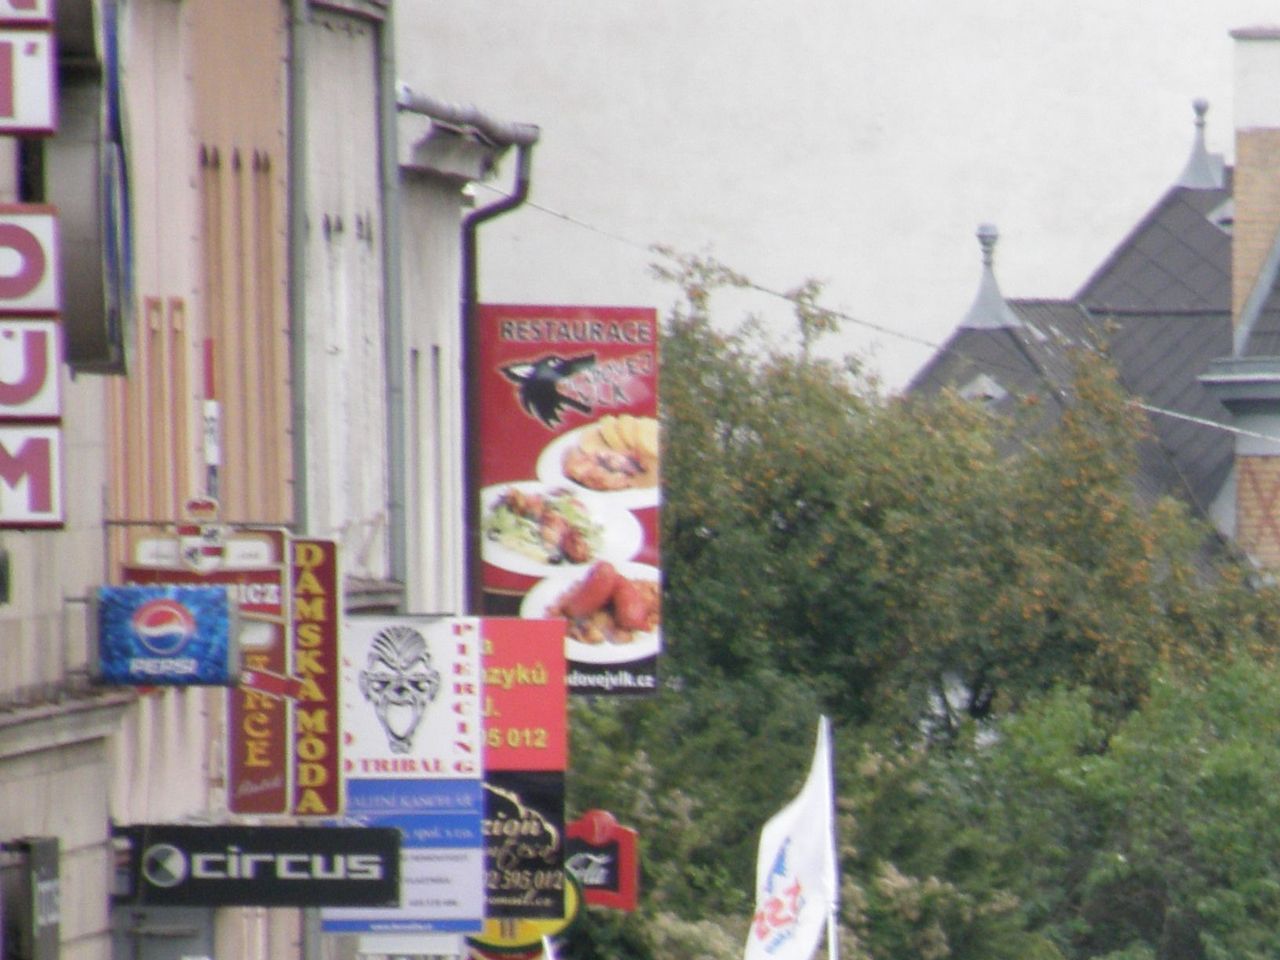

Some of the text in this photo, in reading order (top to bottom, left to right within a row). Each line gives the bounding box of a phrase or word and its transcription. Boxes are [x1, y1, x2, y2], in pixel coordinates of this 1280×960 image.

[501, 319, 650, 344] RESTAURACE
[130, 658, 196, 675] PEPSI
[485, 662, 547, 690] zyků
[452, 623, 474, 773] PIERCING
[507, 728, 547, 748] 012
[296, 708, 328, 813] MODA
[192, 845, 384, 880] circus
